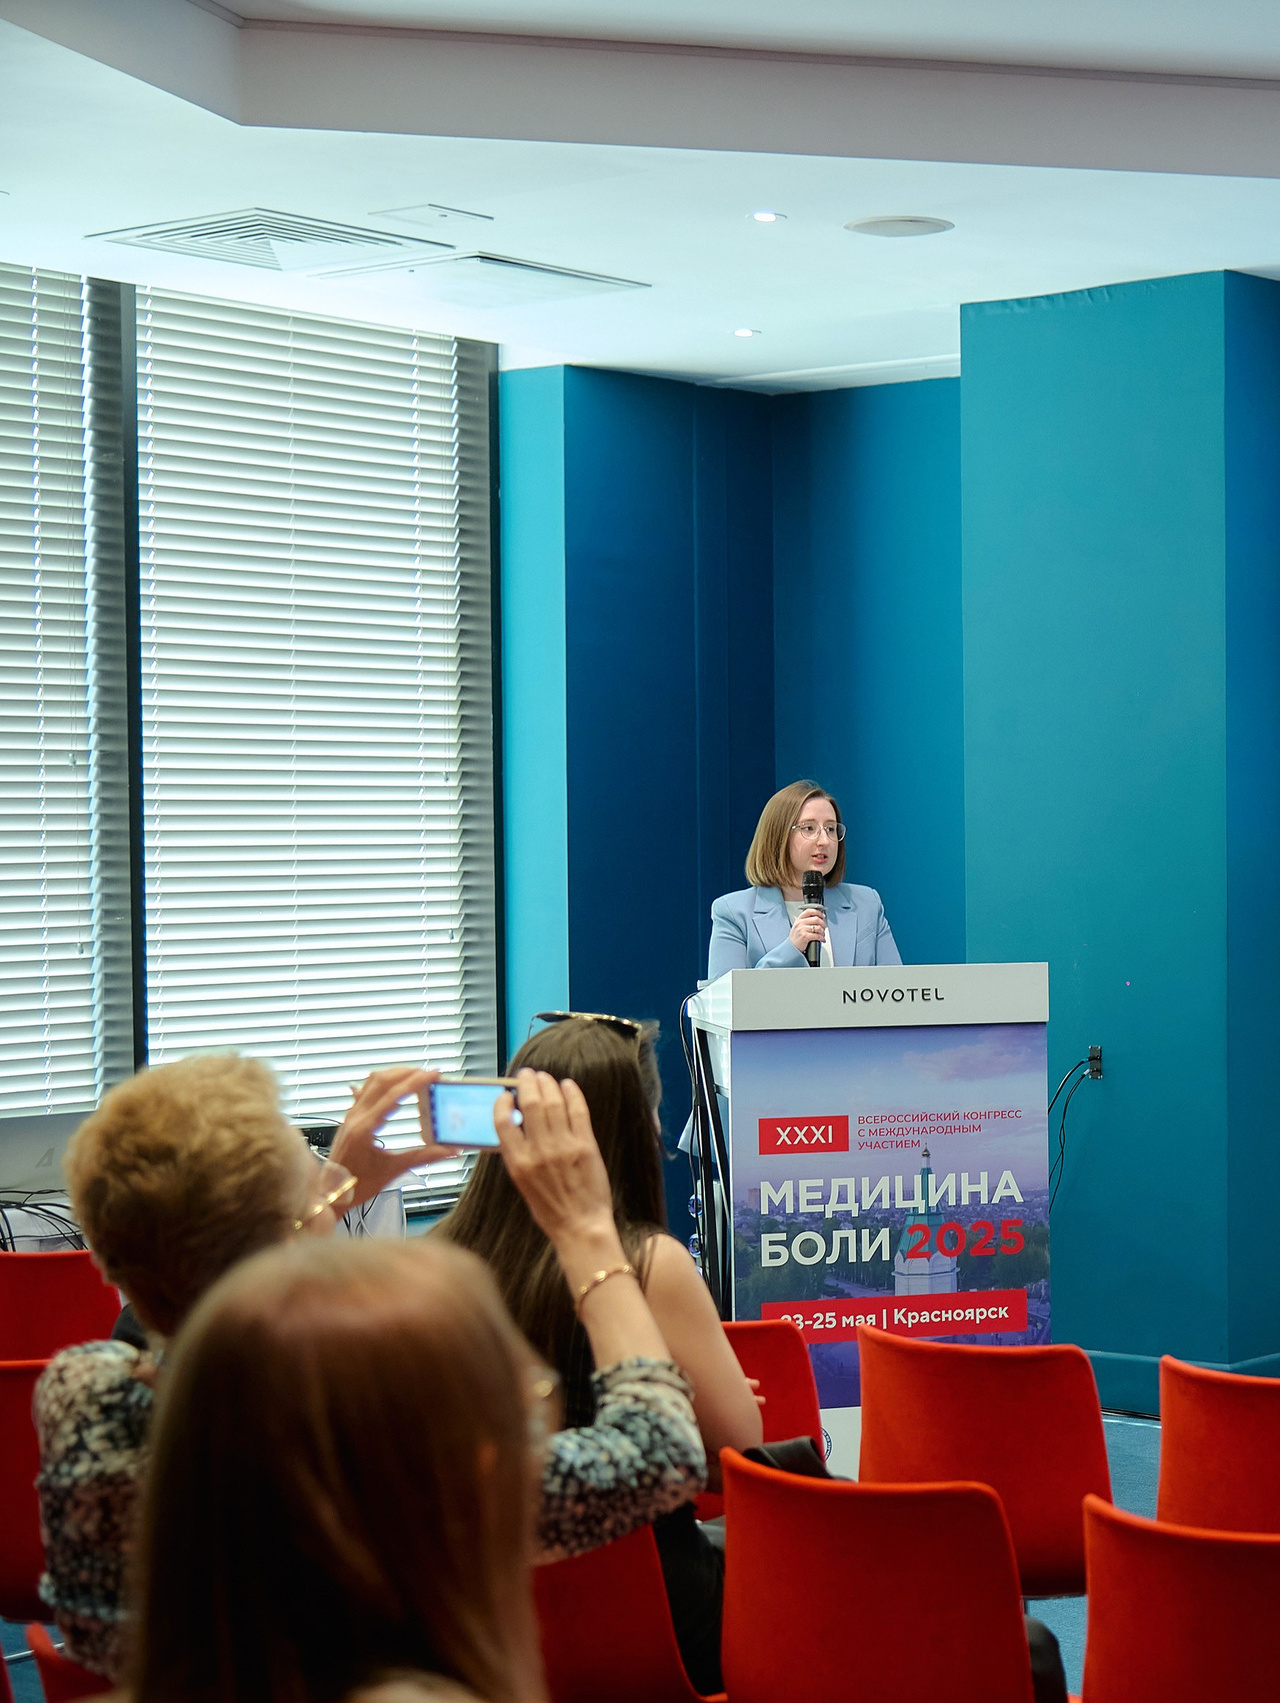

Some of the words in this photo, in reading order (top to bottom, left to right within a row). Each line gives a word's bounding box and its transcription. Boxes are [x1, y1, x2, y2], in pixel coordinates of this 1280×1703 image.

[842, 987, 945, 1004] NOVOTEL
[857, 1110, 960, 1124] ВСЕРОССИЙСКИЙ
[963, 1109, 1022, 1121] КОНГРЕСС
[776, 1125, 833, 1145] XXXI
[857, 1128, 866, 1138] С
[868, 1124, 982, 1138] МЕЖДУНАРОДНЫМ
[858, 1139, 921, 1151] УЧАСТИЕМ
[760, 1170, 1025, 1219] МЕДИЦИНА
[760, 1228, 890, 1268] БОЛИ
[905, 1219, 1025, 1260] 2025
[841, 1315, 876, 1328] мая
[893, 1306, 1009, 1328] Красноярск
